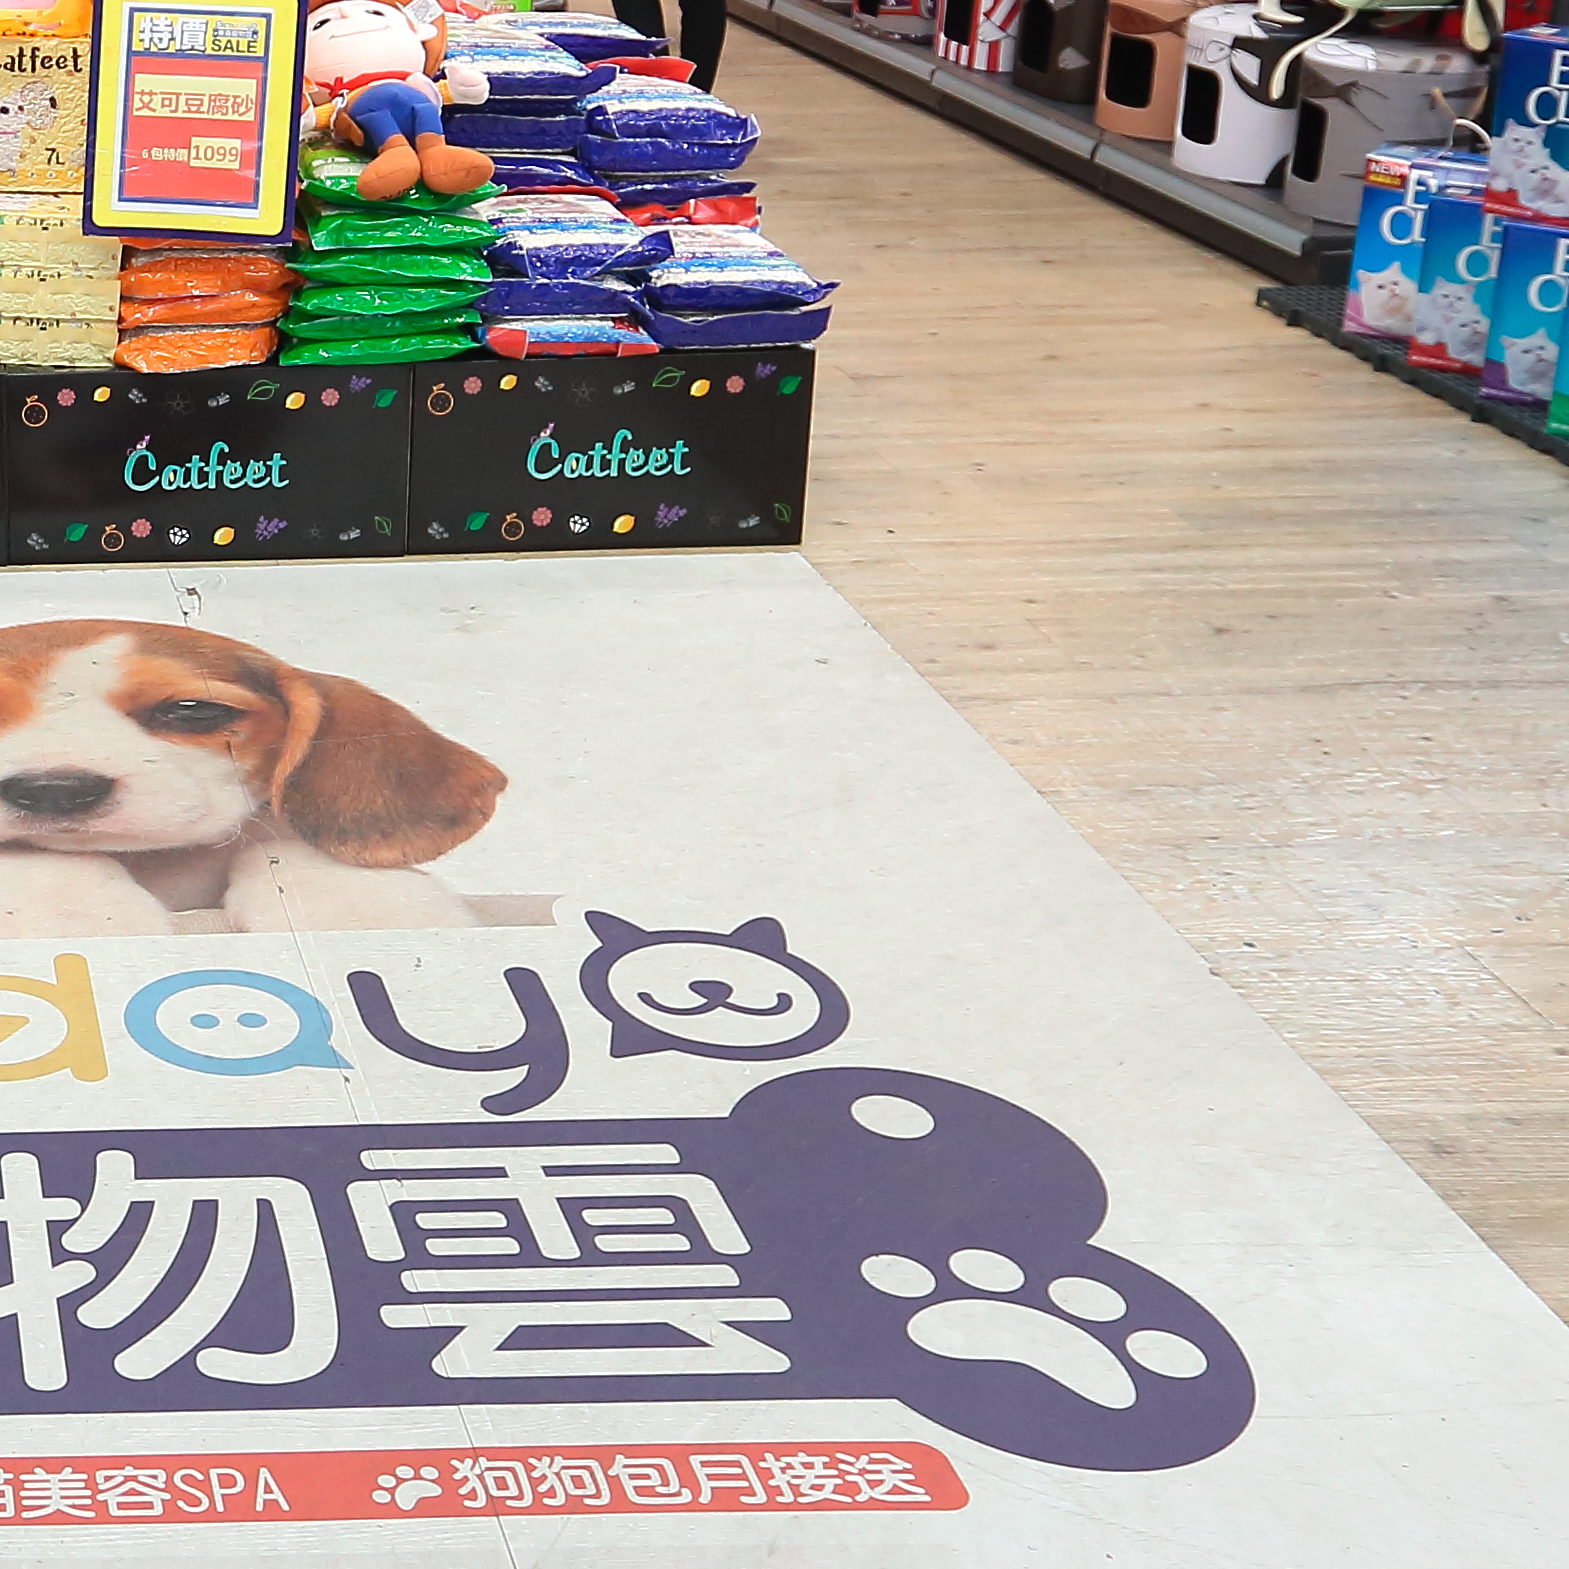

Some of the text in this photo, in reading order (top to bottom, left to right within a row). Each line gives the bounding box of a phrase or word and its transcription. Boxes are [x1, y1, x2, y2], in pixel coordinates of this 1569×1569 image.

[138, 15, 208, 53] 特價
[211, 39, 258, 54] SALE
[134, 89, 255, 117] 艾可豆腐砂
[45, 147, 65, 168] 7L
[192, 144, 239, 163] 1099
[1370, 161, 1403, 175] NEW
[123, 439, 290, 493] Catfeet
[524, 427, 693, 483] Catfeet
[450, 1453, 935, 1515] 狗狗包月接送
